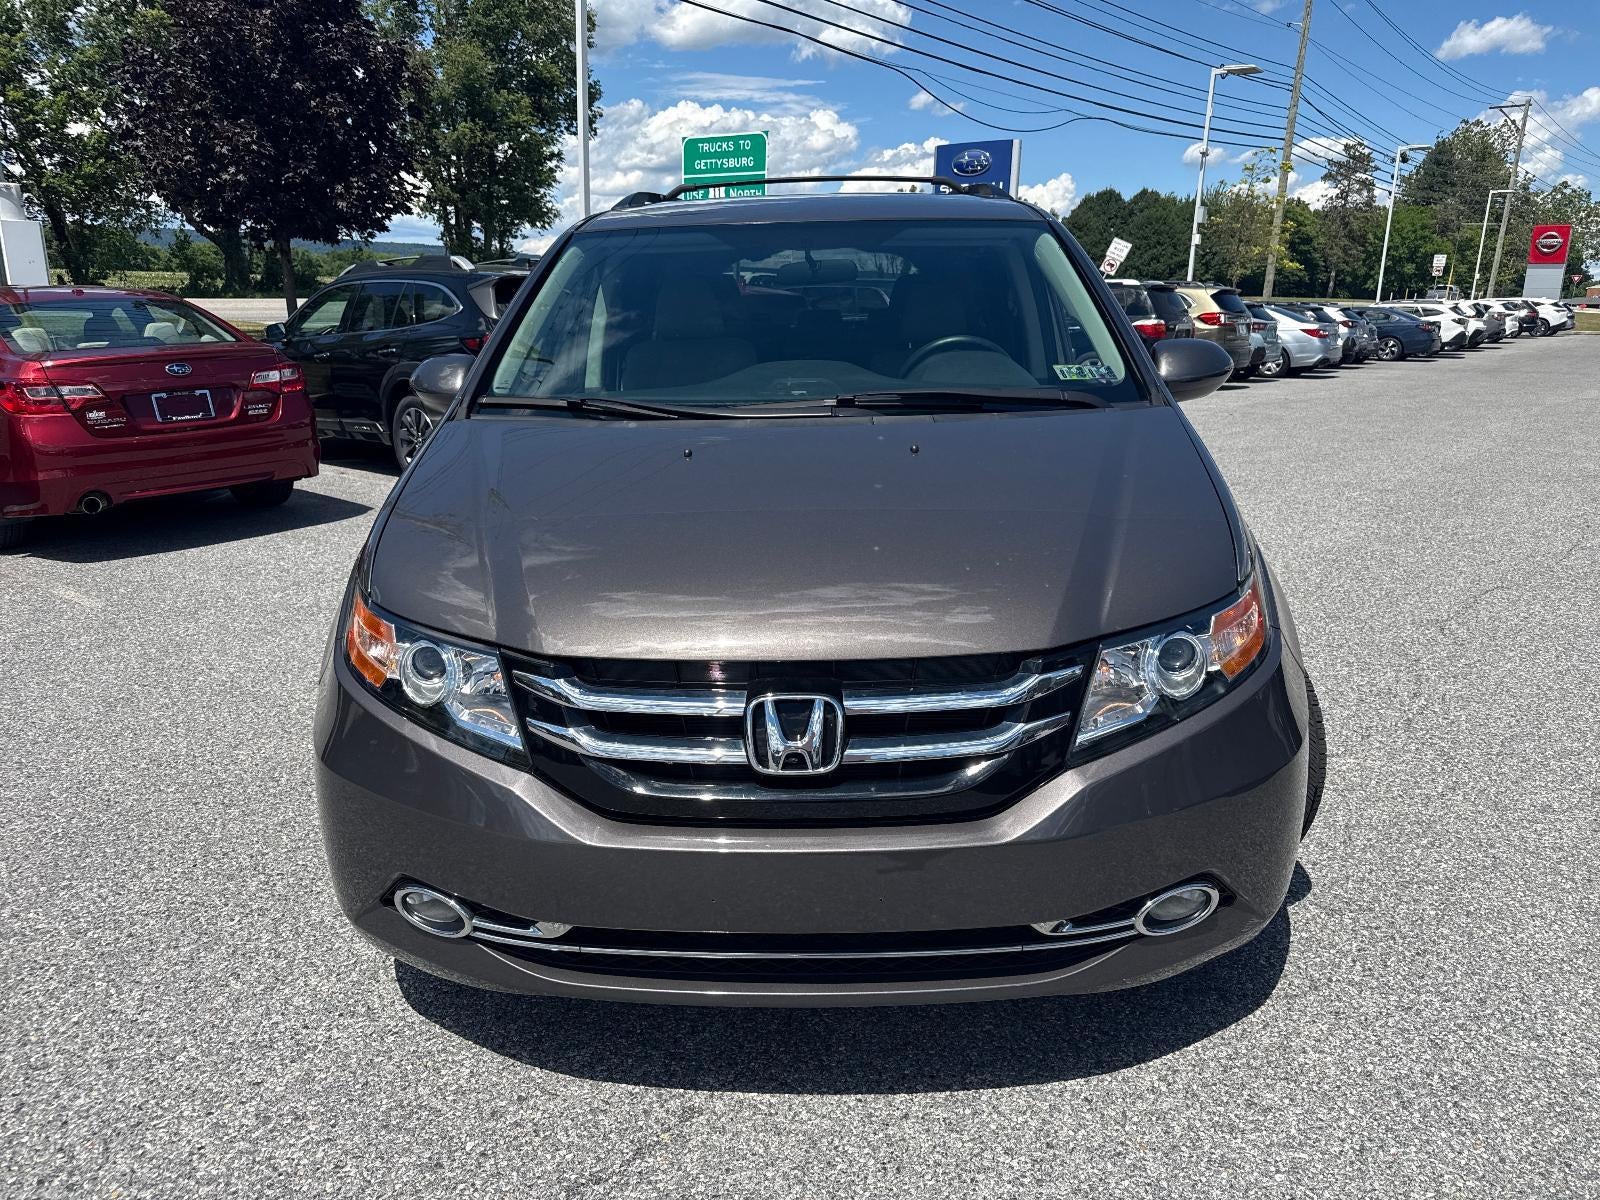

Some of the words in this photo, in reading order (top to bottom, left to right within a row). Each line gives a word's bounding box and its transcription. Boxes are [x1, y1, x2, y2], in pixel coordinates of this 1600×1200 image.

[698, 141, 734, 153] TRUCKS
[739, 140, 751, 150] TO
[694, 157, 754, 169] GETTYSBURG
[686, 191, 704, 200] USE
[729, 188, 762, 198] NORTH
